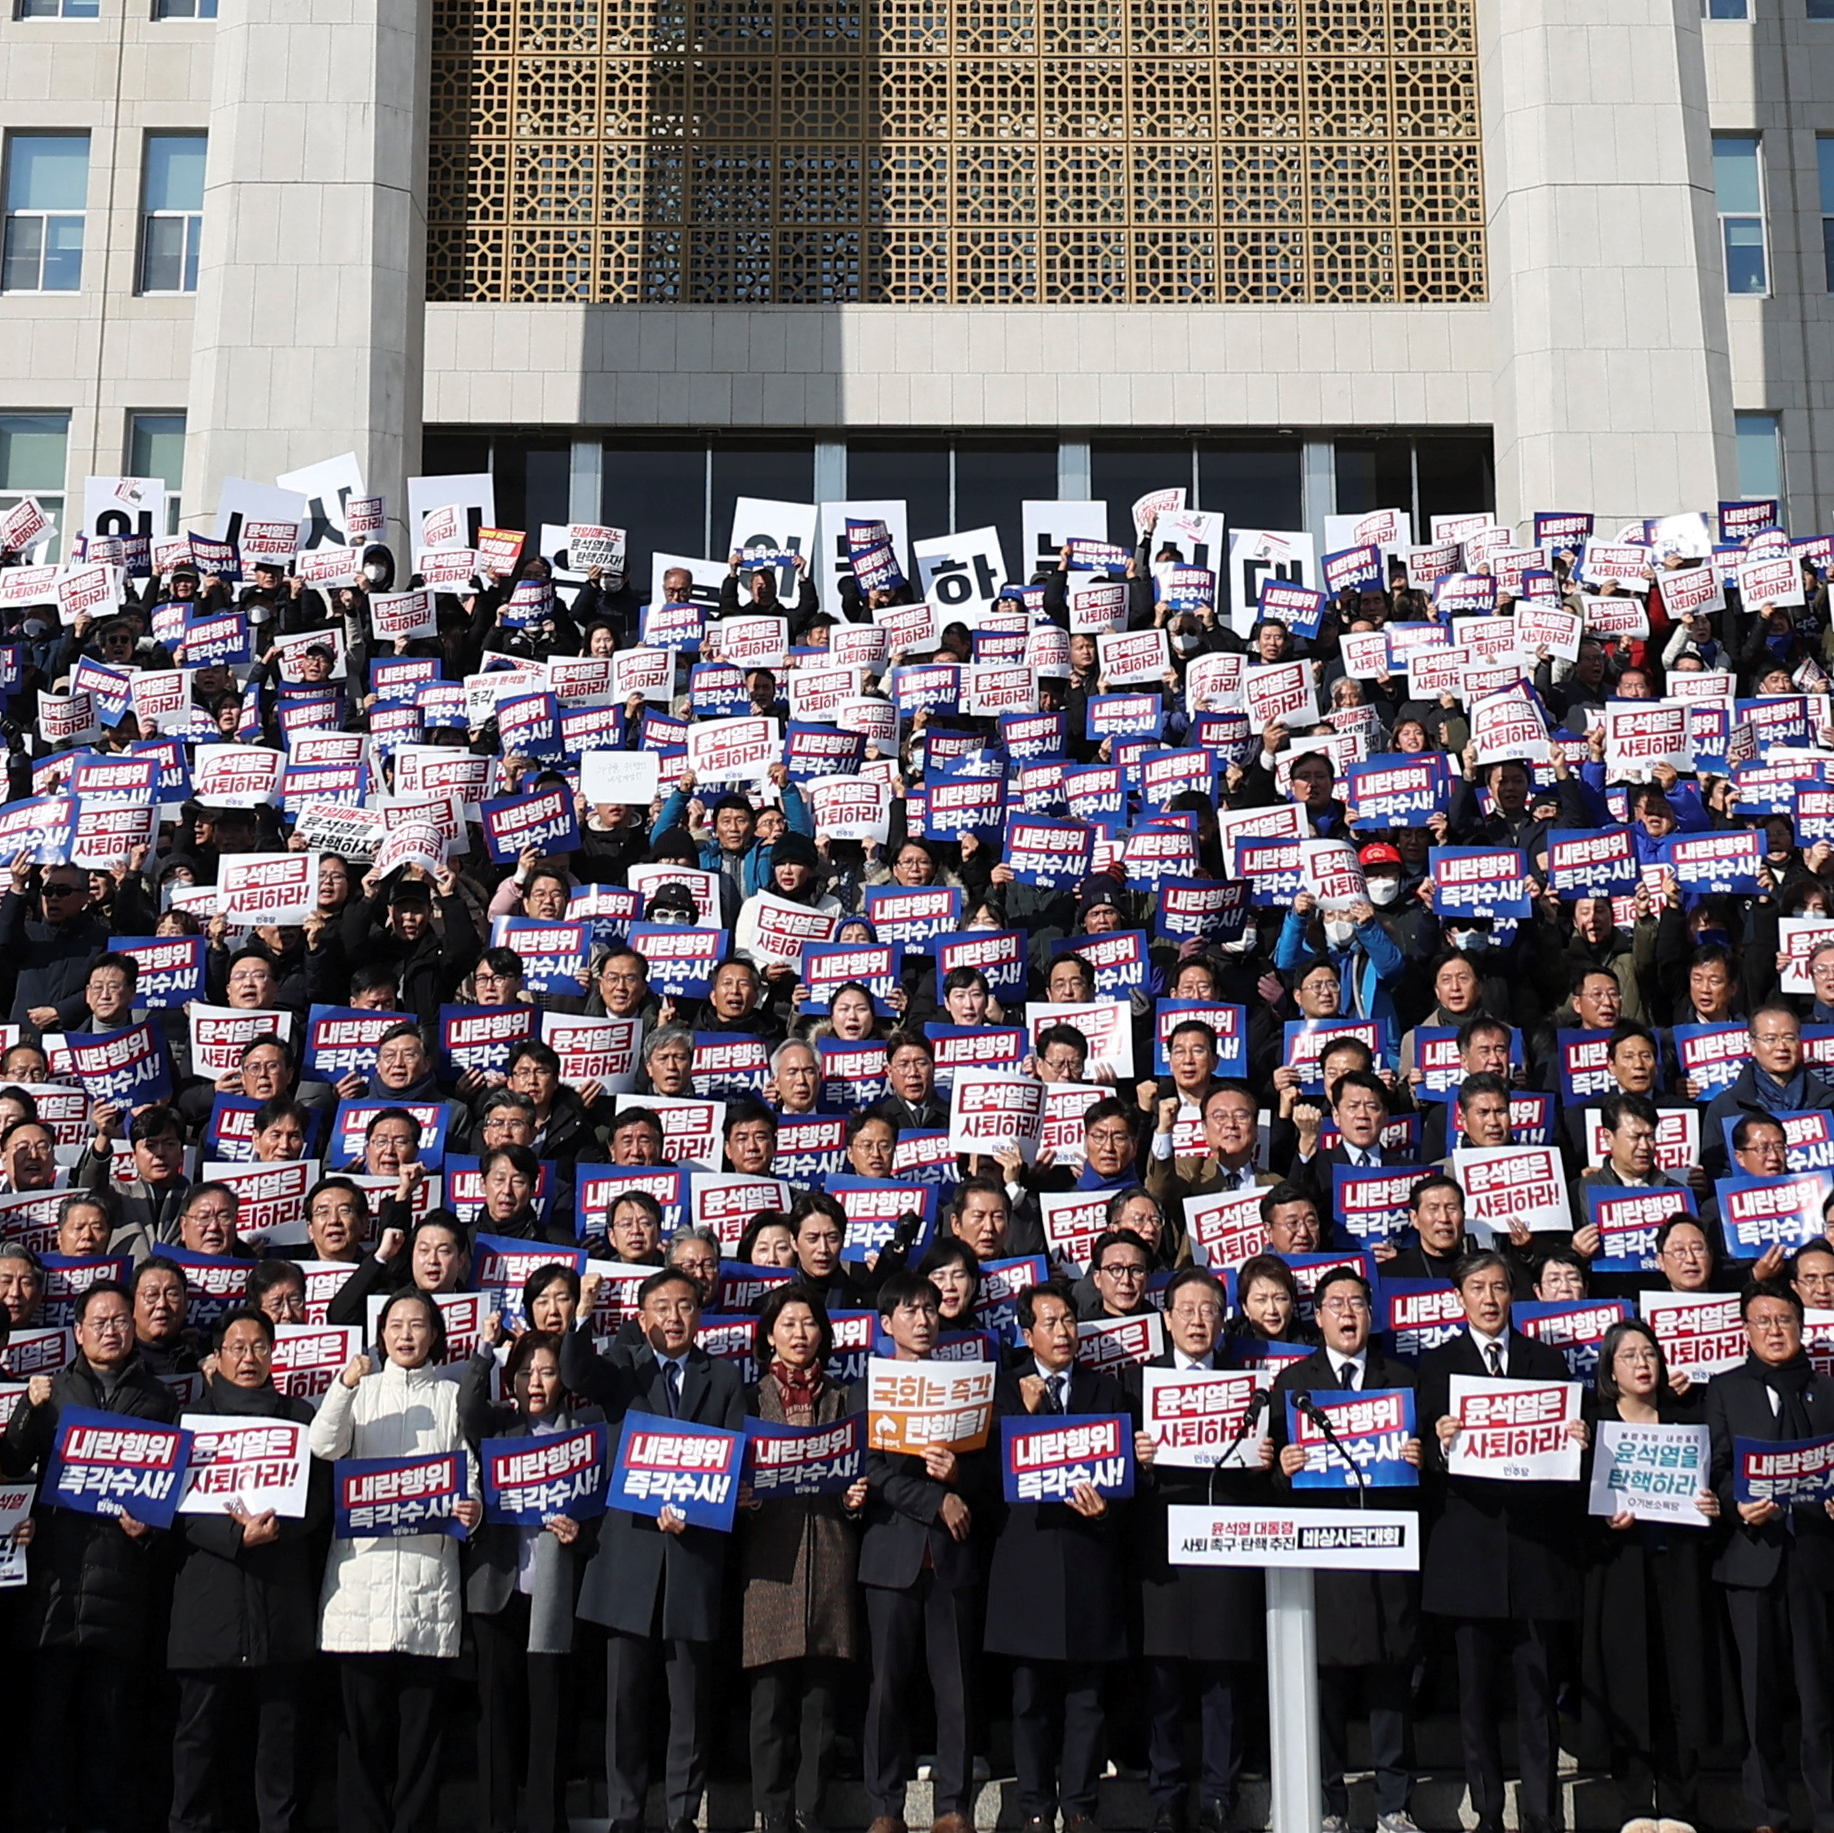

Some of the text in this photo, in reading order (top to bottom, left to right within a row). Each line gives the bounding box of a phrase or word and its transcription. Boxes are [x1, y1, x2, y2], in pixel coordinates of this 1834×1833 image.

[570, 526, 622, 542] 친일매국노
[571, 539, 615, 552] 윤석열을
[576, 552, 623, 566] 탄핵하자!
[693, 724, 767, 757] 윤석열은
[695, 746, 775, 772] 사퇴하라!
[1358, 769, 1431, 796] 내란행위
[491, 802, 570, 836] 내란행위
[1361, 790, 1436, 816] 즉각수사!
[1008, 828, 1088, 854] 내란행위
[1554, 834, 1631, 868] 내란행위
[1674, 834, 1759, 862] 내란행위
[224, 861, 307, 894] 윤석열은
[1009, 850, 1087, 877] 즉각수사!
[1440, 854, 1519, 884] 내란행위
[1554, 859, 1637, 887] 즉각수사!
[1677, 855, 1763, 883] 즉각수사!
[226, 886, 311, 914] 사퇴하라!
[1165, 886, 1243, 916] 내란행위
[1440, 879, 1524, 906] 즉각수사!
[871, 894, 956, 924] 내란행위
[1165, 906, 1244, 932] 즉각수사!
[634, 931, 716, 959] 내란행위
[810, 949, 892, 981] 내란행위
[447, 1014, 531, 1046] 내란행위
[551, 1026, 631, 1058] 윤석열은
[71, 1028, 150, 1069] 내란행위
[961, 1081, 1041, 1114] 윤석열은
[960, 1109, 1040, 1139] 사퇴하라!
[1464, 1154, 1552, 1194] 윤석열은
[702, 1185, 780, 1219] 윤석열은
[1474, 1184, 1561, 1220] 사퇴하라!
[1731, 1182, 1820, 1221] 내란행위
[874, 1373, 992, 1407] 국회는 즉각
[1155, 1381, 1251, 1415] 윤석열은
[1463, 1389, 1567, 1426] 윤석열은
[905, 1408, 987, 1444] 탄핵을!
[66, 1429, 176, 1463] 내란행위
[191, 1430, 290, 1463] 윤석열은
[629, 1434, 729, 1468] 내란행위
[755, 1424, 852, 1464] 내란행위
[1015, 1423, 1116, 1466] 내란행위
[1465, 1428, 1568, 1459] 사퇴하라!
[1615, 1442, 1698, 1468] 윤석열을
[496, 1436, 595, 1484] 내란행위
[754, 1450, 859, 1488] 즉각수사!
[57, 1467, 176, 1500] 즉각수사!
[348, 1461, 451, 1504] 내란행위
[623, 1468, 727, 1503] 즉각수사!
[1608, 1469, 1697, 1496] 탄핵하라
[1182, 1538, 1207, 1552] 사퇴
[1270, 1536, 1295, 1551] 추진
[1211, 1521, 1294, 1536] 윤석열 대통령
[1302, 1527, 1400, 1547] 비상시국대회
